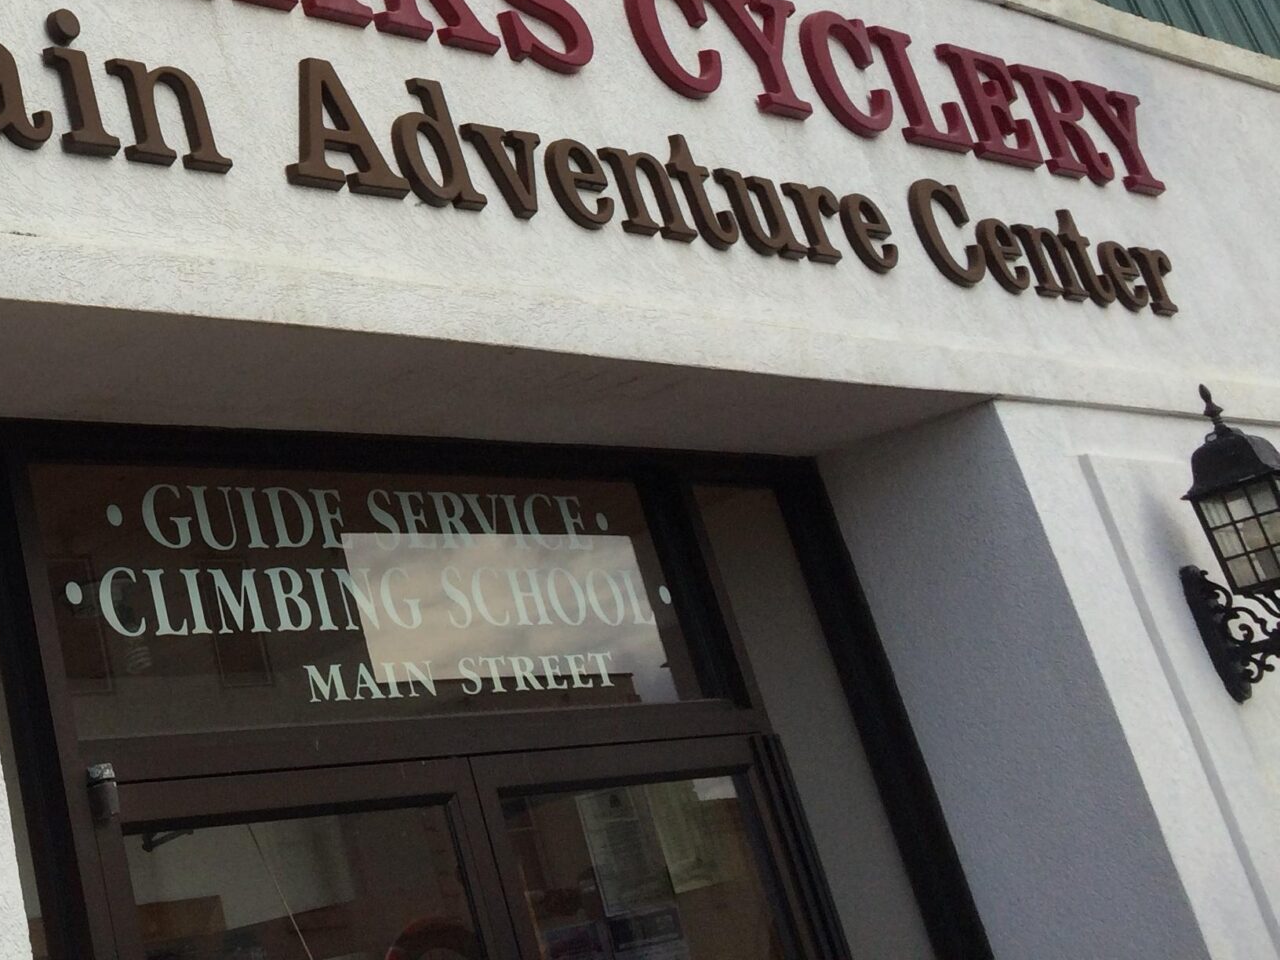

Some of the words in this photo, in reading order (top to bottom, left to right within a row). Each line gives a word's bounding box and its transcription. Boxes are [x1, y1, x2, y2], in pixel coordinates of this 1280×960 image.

[287, 57, 898, 274] Adventure
[909, 179, 1179, 317] Center
[142, 484, 352, 550] GUIDE
[367, 489, 593, 551] SERVICE
[99, 566, 421, 637] CLIMBING
[441, 566, 656, 628] SCHOOL
[303, 660, 438, 703] MAIN
[457, 651, 615, 695] STREET
